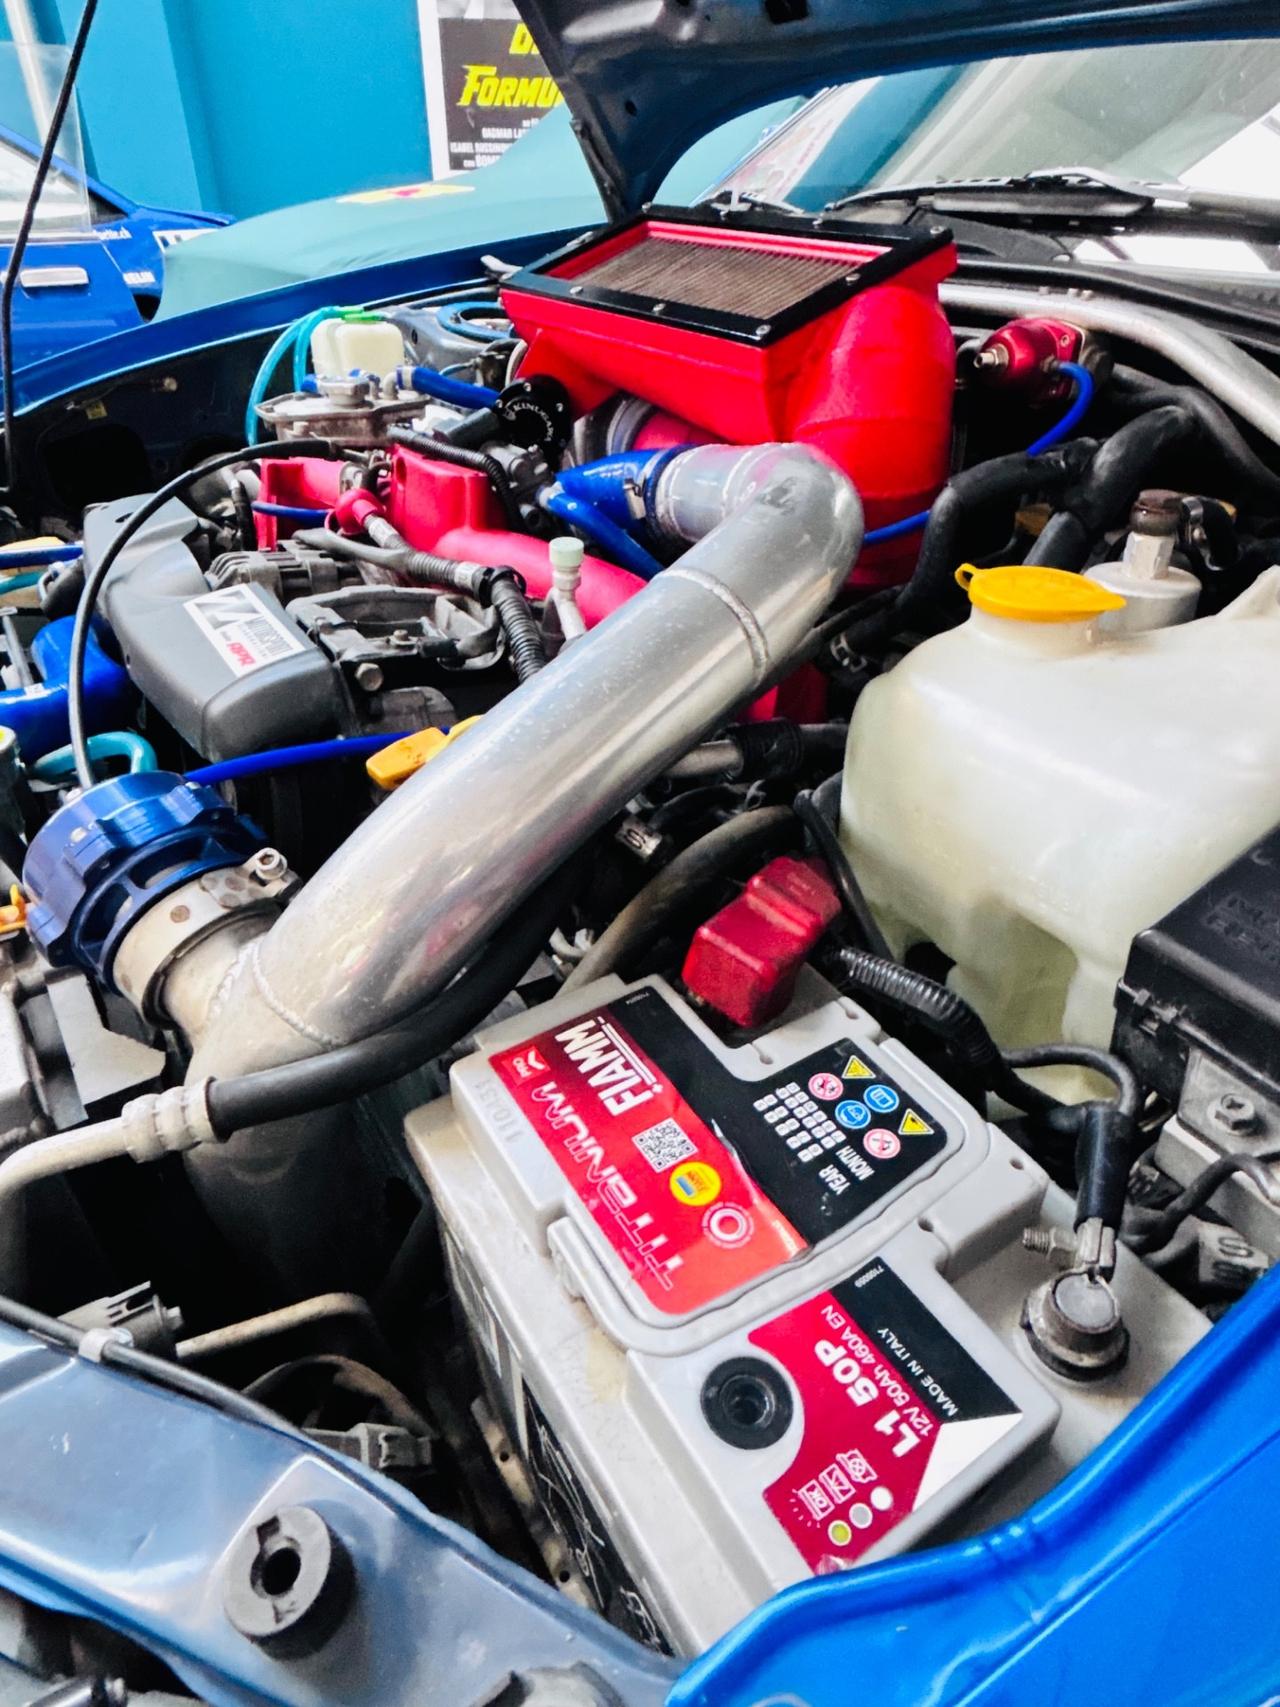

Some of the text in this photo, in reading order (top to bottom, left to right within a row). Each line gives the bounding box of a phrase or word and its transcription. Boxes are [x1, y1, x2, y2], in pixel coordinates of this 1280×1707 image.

[512, 1056, 533, 1078] PRO
[554, 1019, 654, 1116] FIAMM
[818, 1164, 851, 1195] YEAR
[835, 1145, 875, 1180] MONTH
[814, 1340, 921, 1457] L1 50P
[821, 1304, 934, 1436] 12V 50Ah 460A EN
[877, 1328, 959, 1417] MADE IN ITALY
